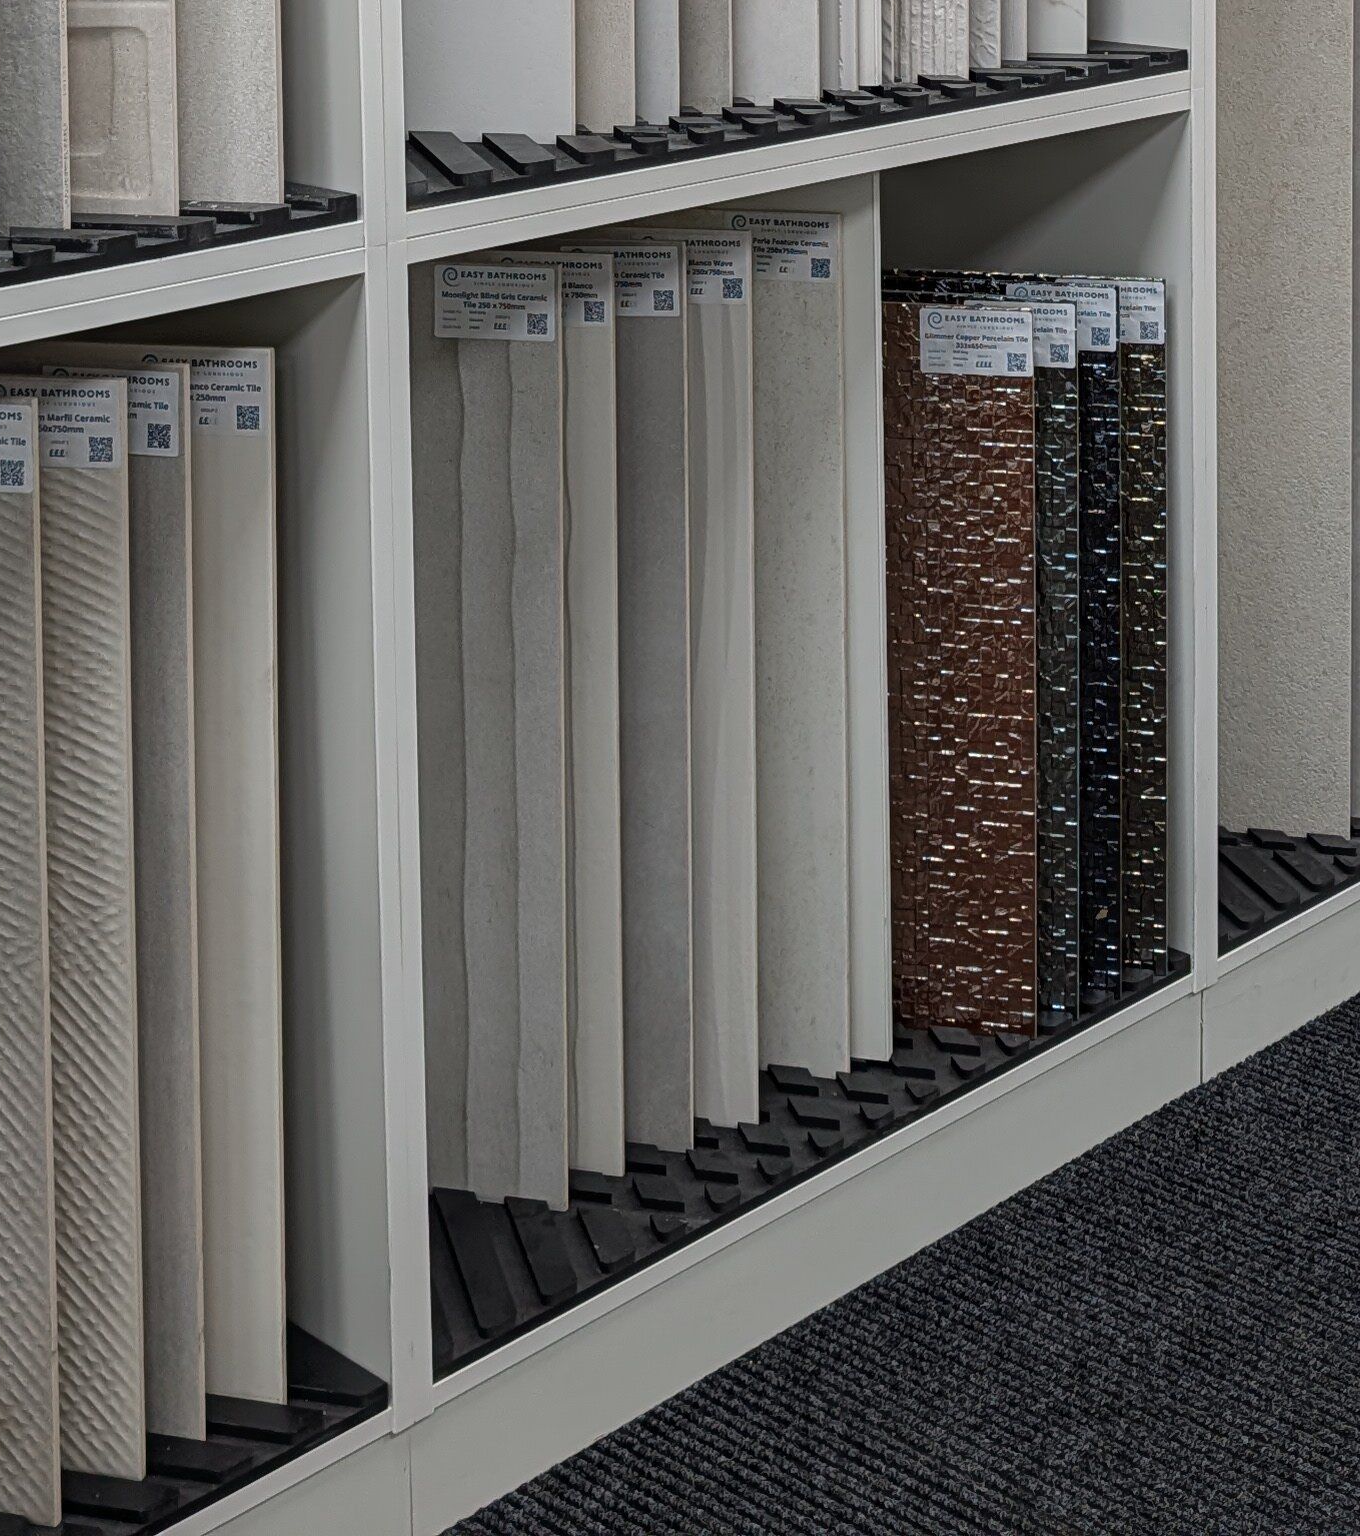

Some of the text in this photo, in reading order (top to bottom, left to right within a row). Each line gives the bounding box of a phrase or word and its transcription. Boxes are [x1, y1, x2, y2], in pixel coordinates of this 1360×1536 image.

[749, 218, 830, 229] EASY BATHROOMS
[613, 251, 671, 259] BATHROOMS
[461, 271, 547, 281] EASY BATHROOMS
[517, 294, 547, 302] Ceramic
[1055, 291, 1109, 299] BATHROOMS
[945, 314, 1025, 324] EASY BATHROOMS
[192, 359, 258, 369] BATHROOMS
[211, 384, 261, 392] Ceramic Tile
[10, 388, 110, 399] EASY BATHROOMS
[195, 394, 226, 402] 250mm
[154, 402, 168, 411] Tile
[47, 413, 110, 423] Marfil Ceramic
[10, 437, 26, 446] Tile
